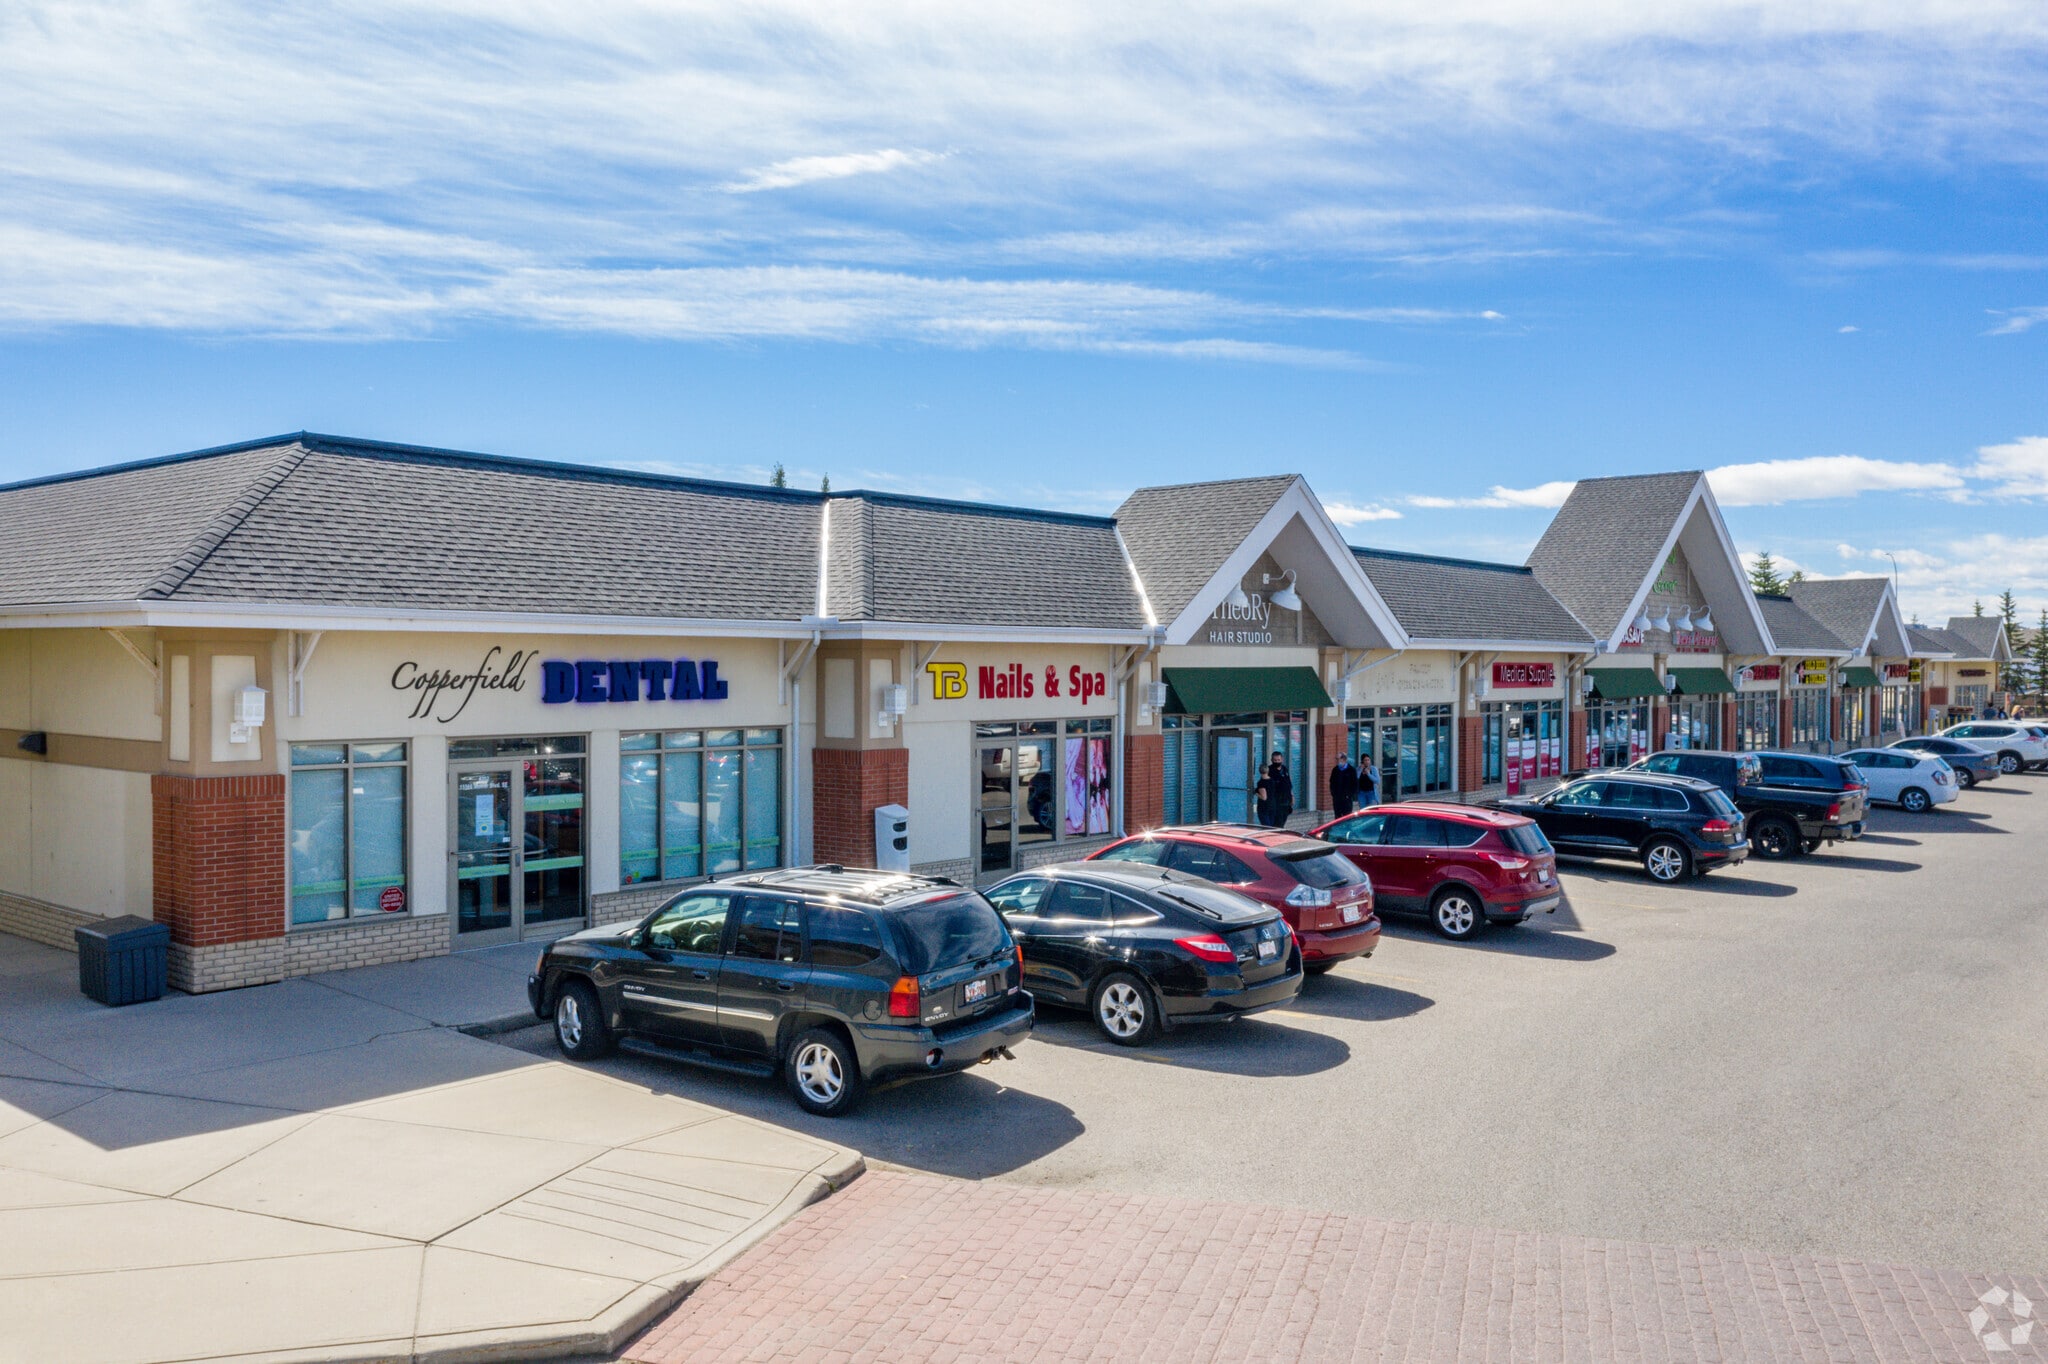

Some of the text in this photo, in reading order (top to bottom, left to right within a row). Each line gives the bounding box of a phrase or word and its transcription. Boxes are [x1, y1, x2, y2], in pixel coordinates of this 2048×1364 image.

[1209, 631, 1272, 644] HAIR STUDIO
[1501, 665, 1526, 682] Medical
[391, 645, 728, 723] Copperfield DENTAL
[926, 662, 1105, 705] TB Nails & Spa
[925, 1012, 949, 1022] ENVOY
